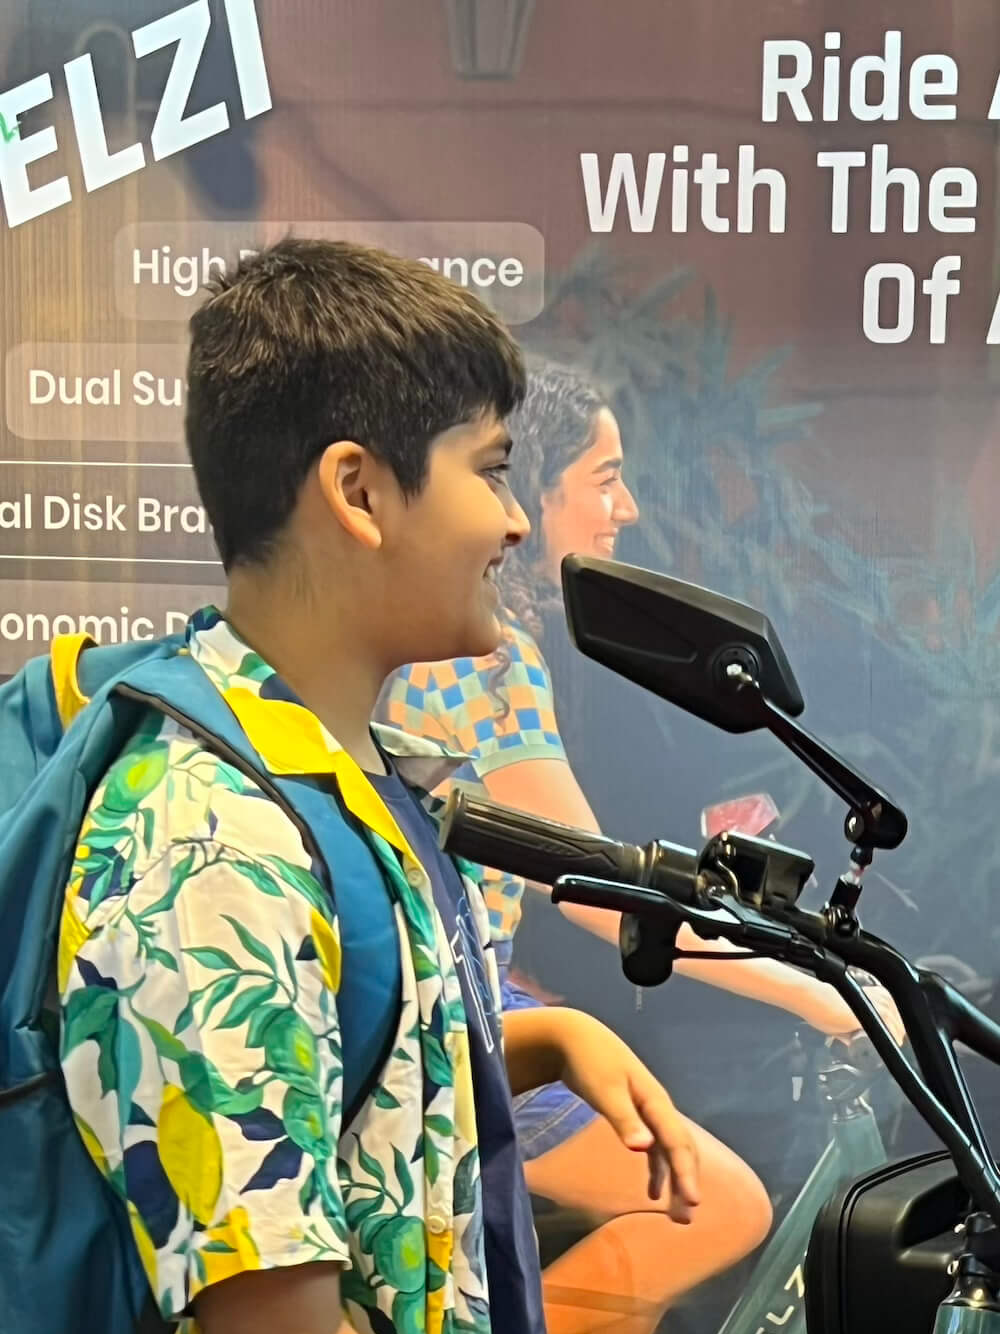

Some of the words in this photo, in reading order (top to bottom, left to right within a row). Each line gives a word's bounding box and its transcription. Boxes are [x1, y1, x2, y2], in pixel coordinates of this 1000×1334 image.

[762, 30, 958, 122] Ride
[580, 144, 787, 234] With
[816, 143, 978, 234] The
[133, 245, 227, 297] High
[862, 255, 962, 344] Of
[29, 368, 121, 405] Dual
[132, 370, 189, 406] Su
[43, 492, 128, 532] Disk
[138, 496, 214, 534] Bra
